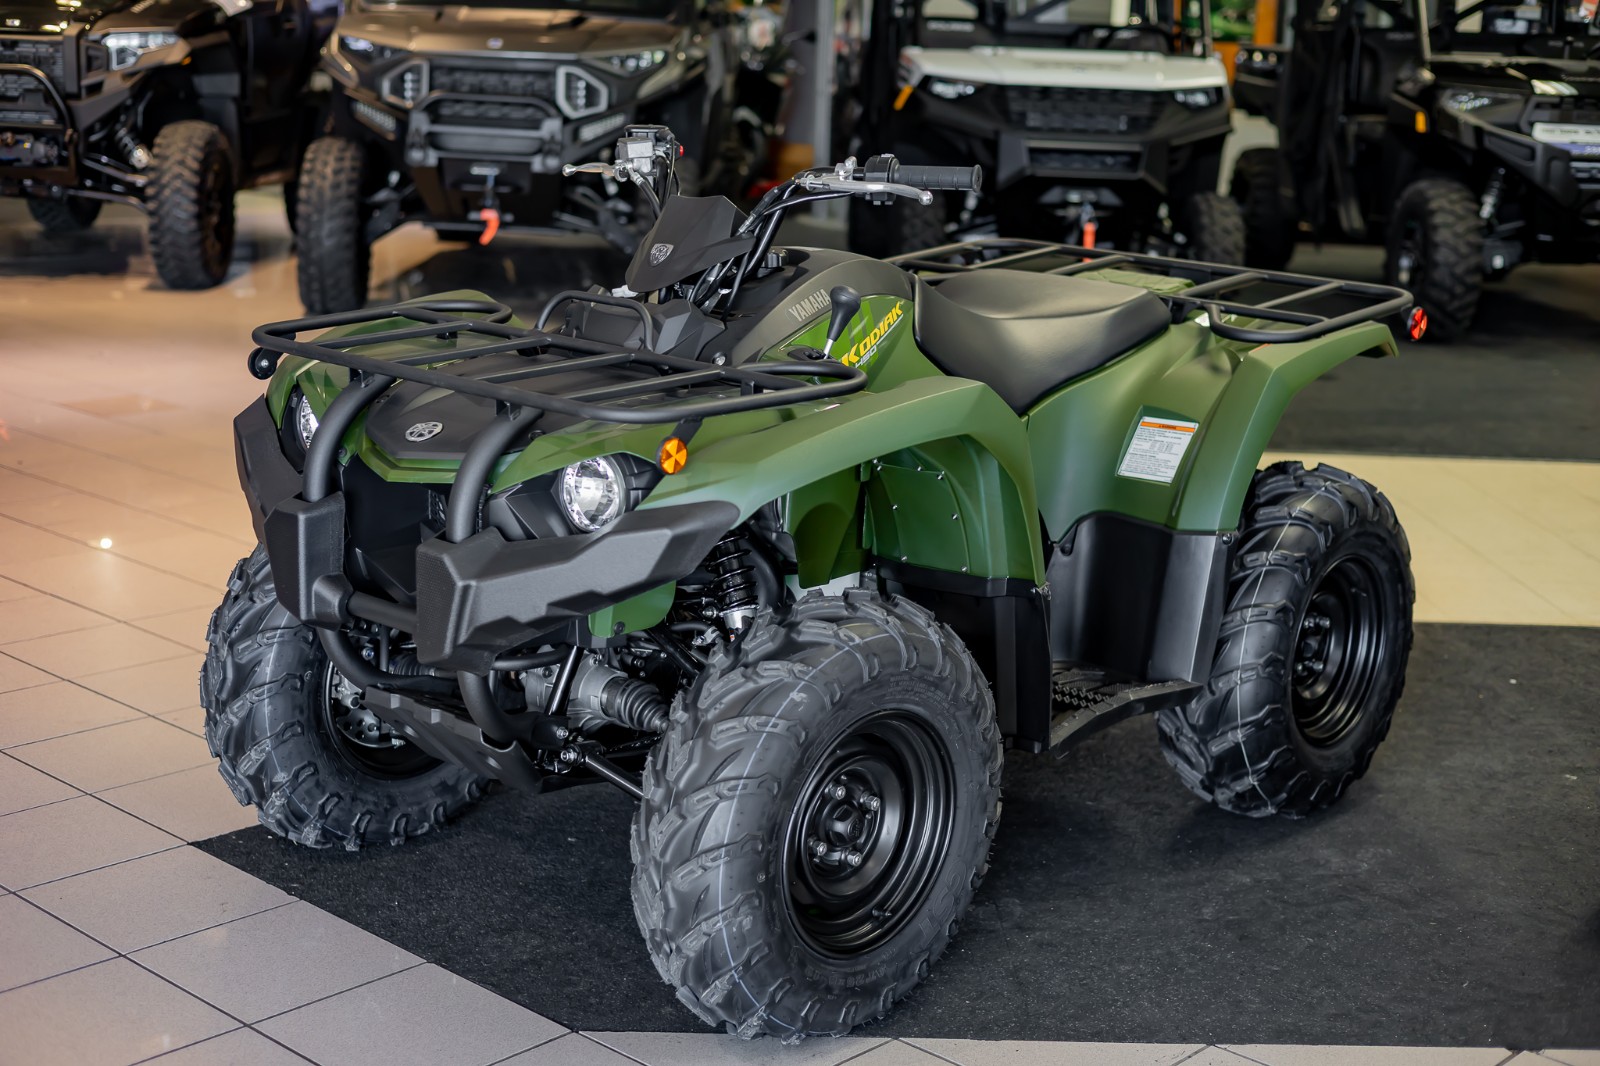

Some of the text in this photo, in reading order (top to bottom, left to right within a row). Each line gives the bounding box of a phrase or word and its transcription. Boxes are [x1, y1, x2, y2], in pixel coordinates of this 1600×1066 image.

[790, 289, 831, 321] YAMAHA
[841, 301, 903, 367] KODIAK
[855, 344, 877, 368] 450
